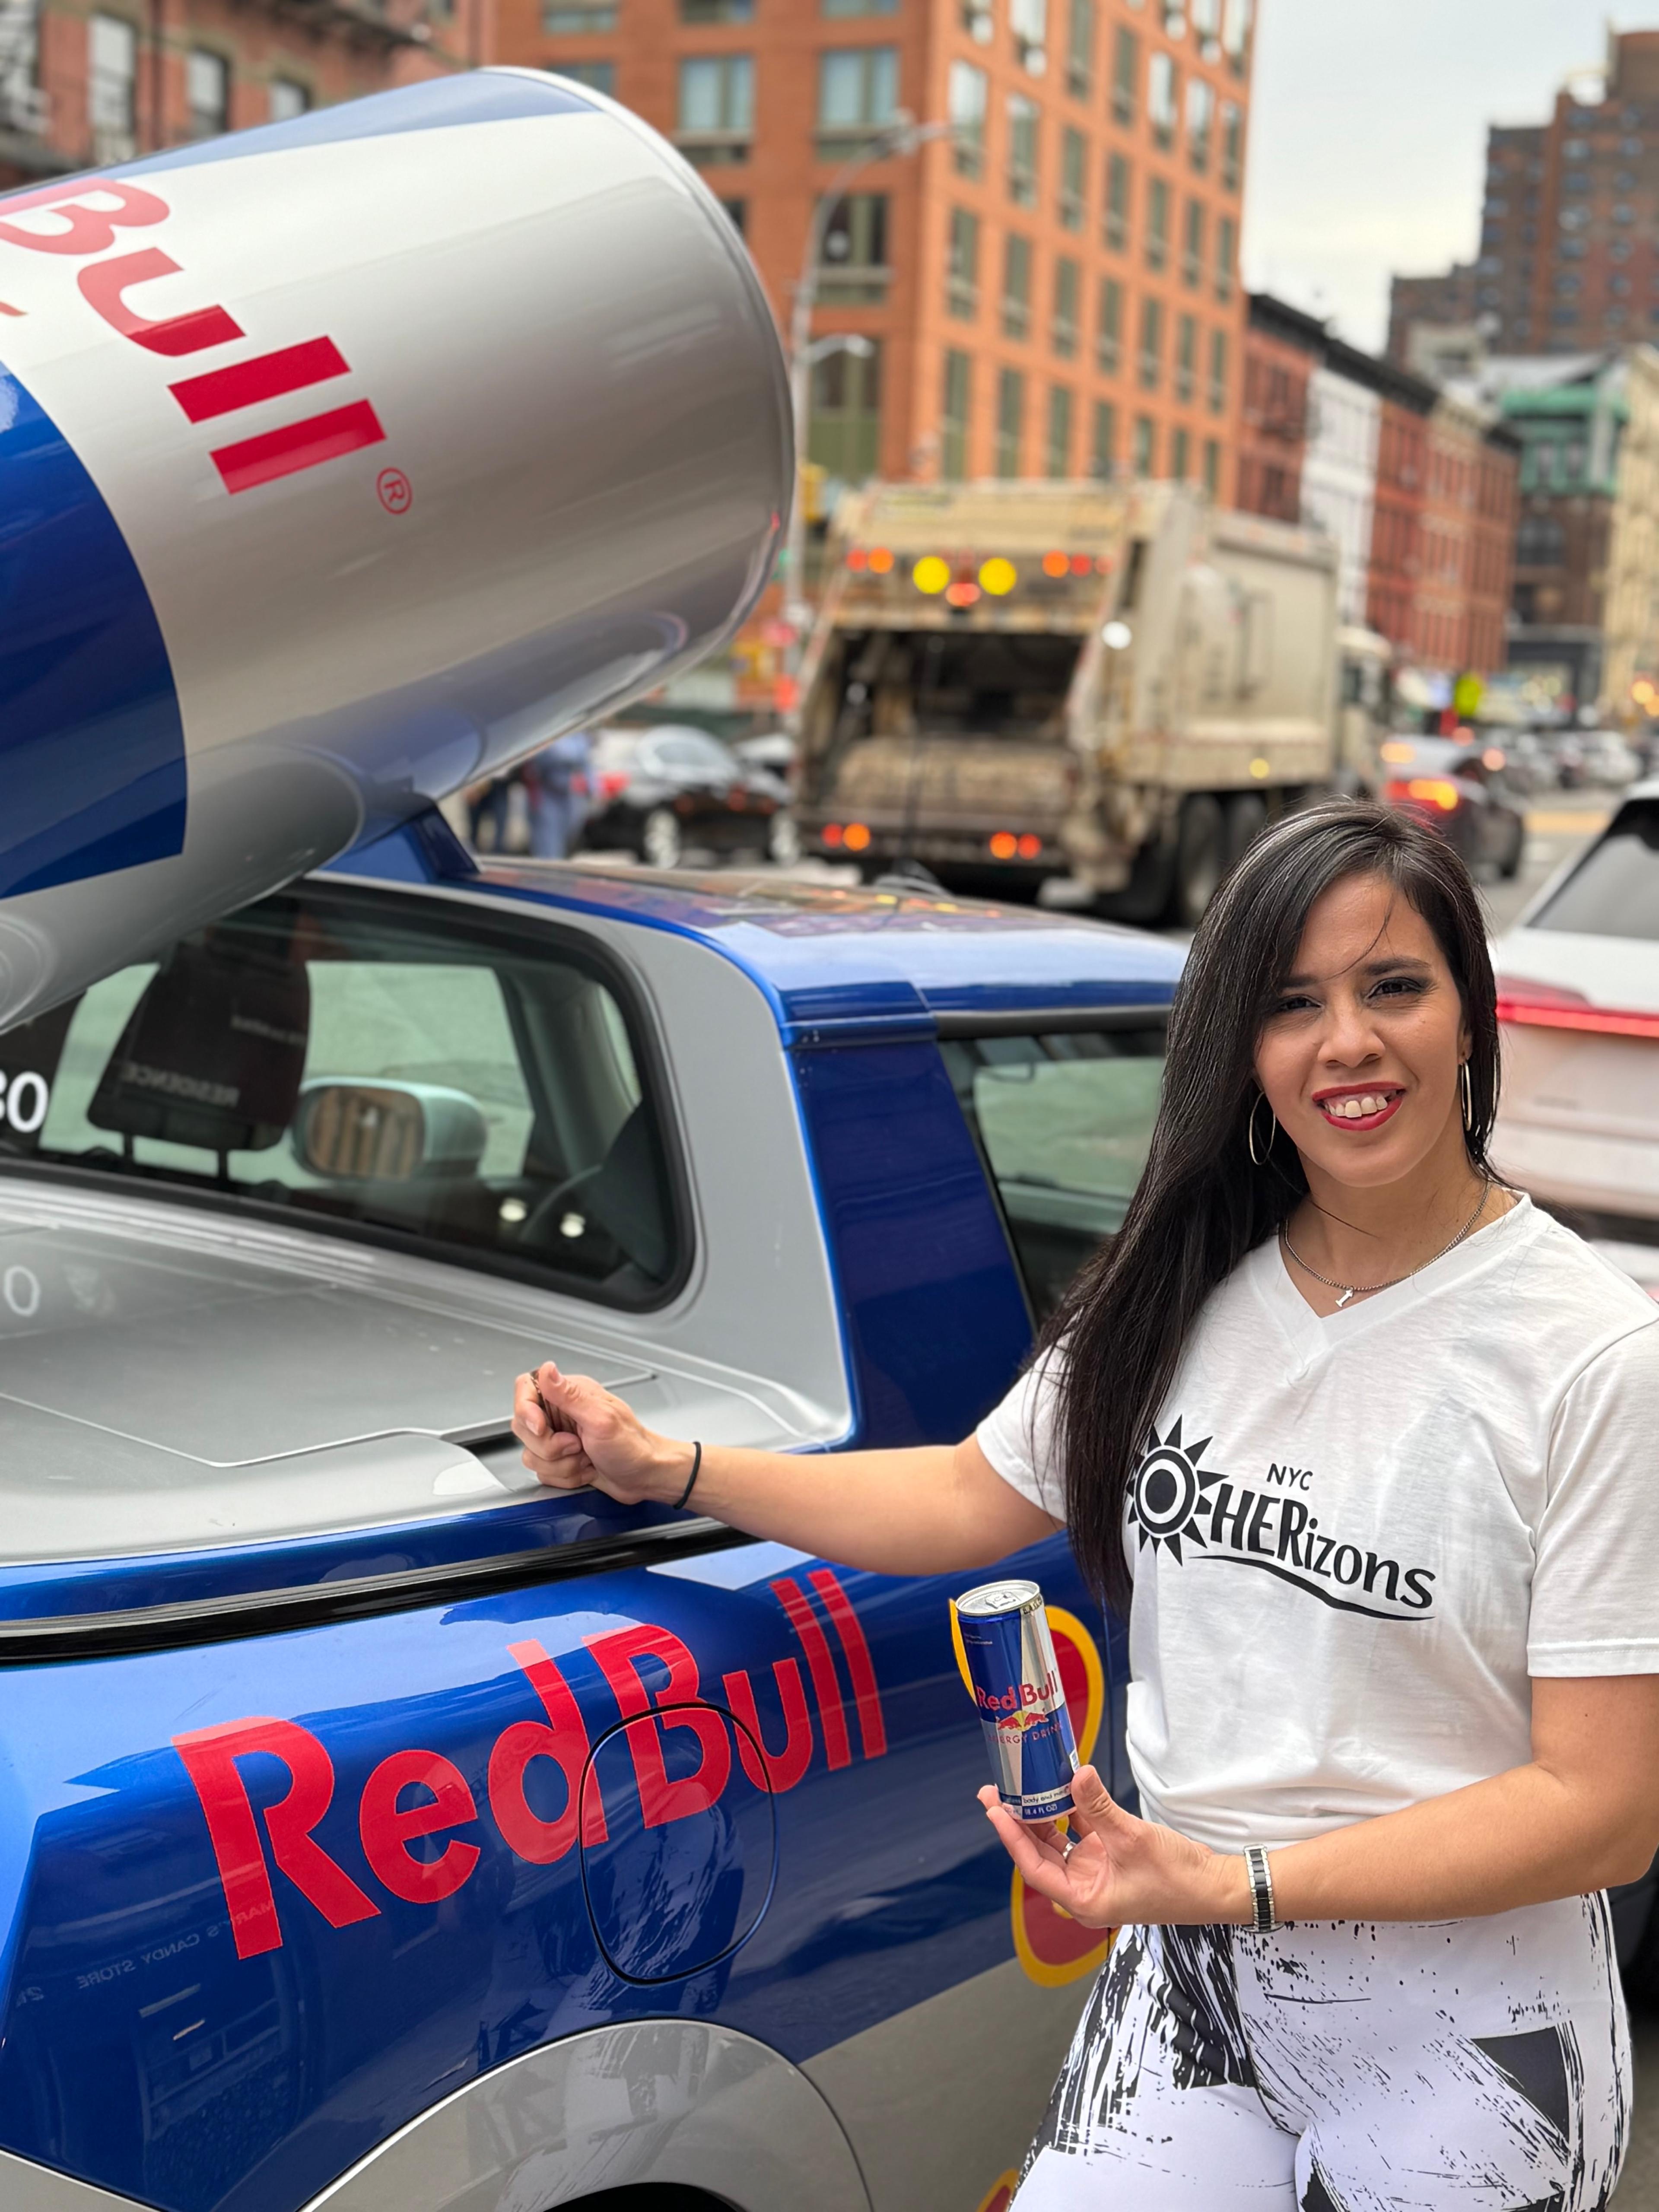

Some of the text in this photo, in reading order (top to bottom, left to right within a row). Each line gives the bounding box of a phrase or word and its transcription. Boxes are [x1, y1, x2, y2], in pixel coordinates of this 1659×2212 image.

[0, 178, 386, 495] Bull
[0, 1069, 50, 1133] 0
[1267, 1463, 1313, 1491] NYC
[1210, 1483, 1437, 1609] HERizons
[976, 1670, 1058, 1711] Red Bull
[171, 1569, 887, 1960] Red Bull
